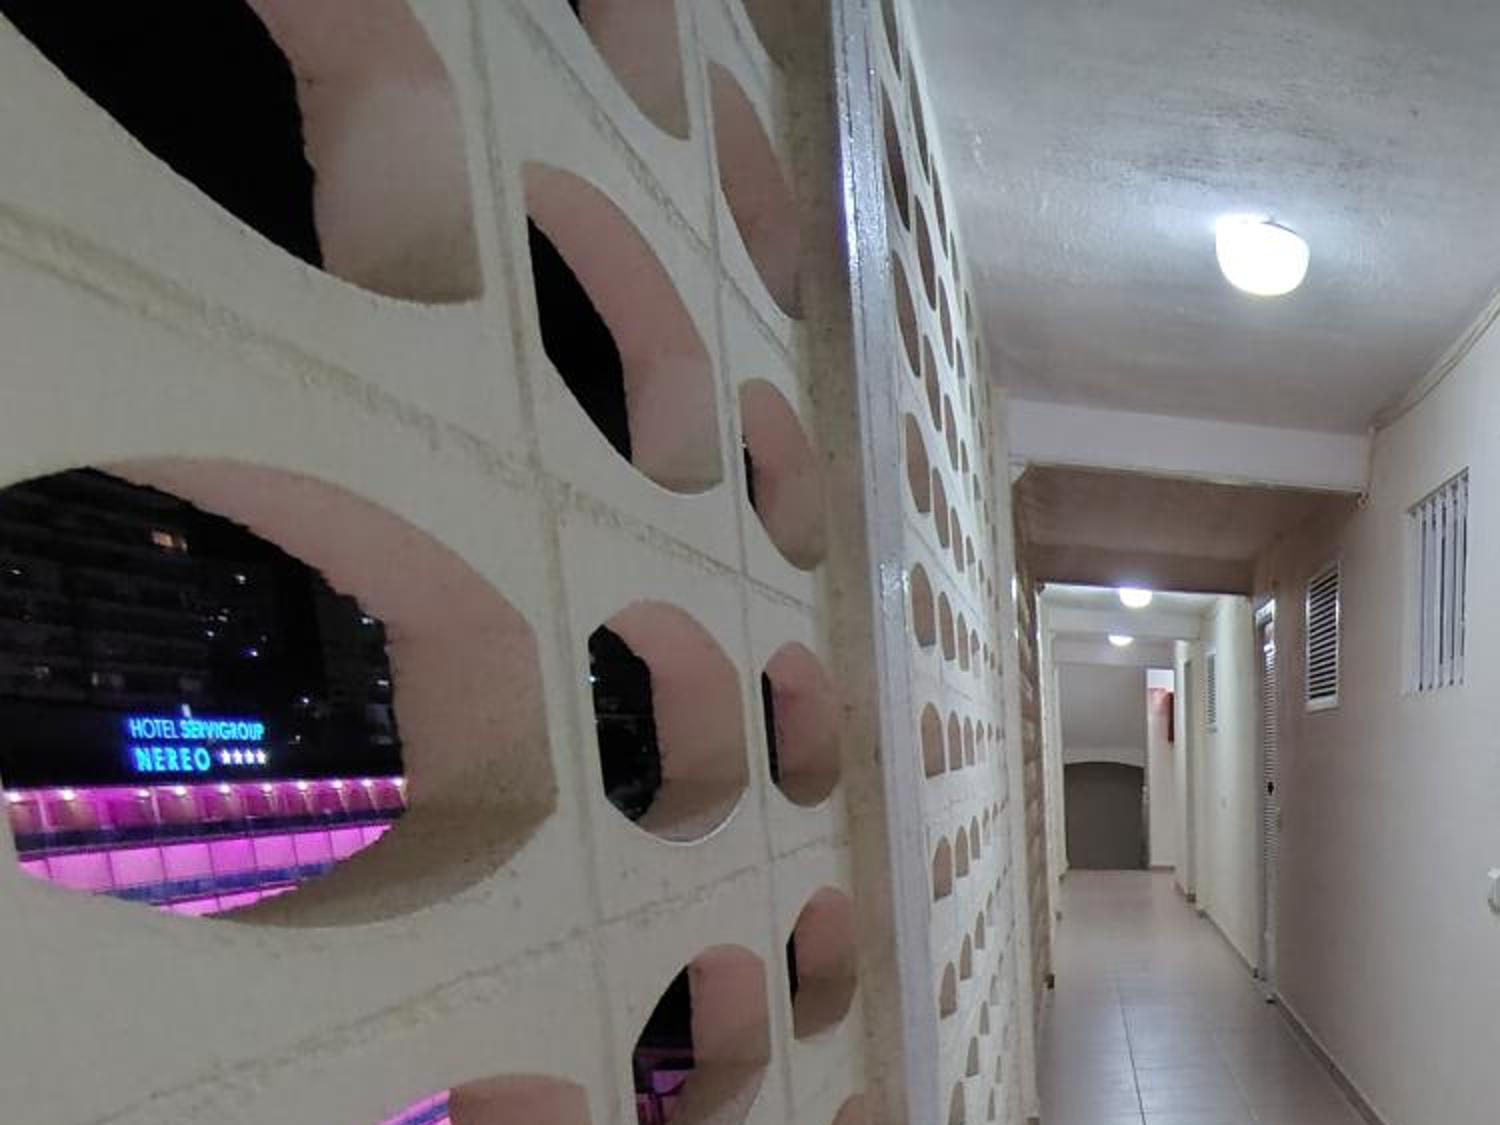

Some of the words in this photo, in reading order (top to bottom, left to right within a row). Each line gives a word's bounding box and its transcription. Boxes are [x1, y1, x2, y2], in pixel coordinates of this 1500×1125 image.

[129, 717, 179, 740] HOTEL
[179, 719, 265, 742] SERVIGROUP
[134, 746, 212, 772] NEREO
